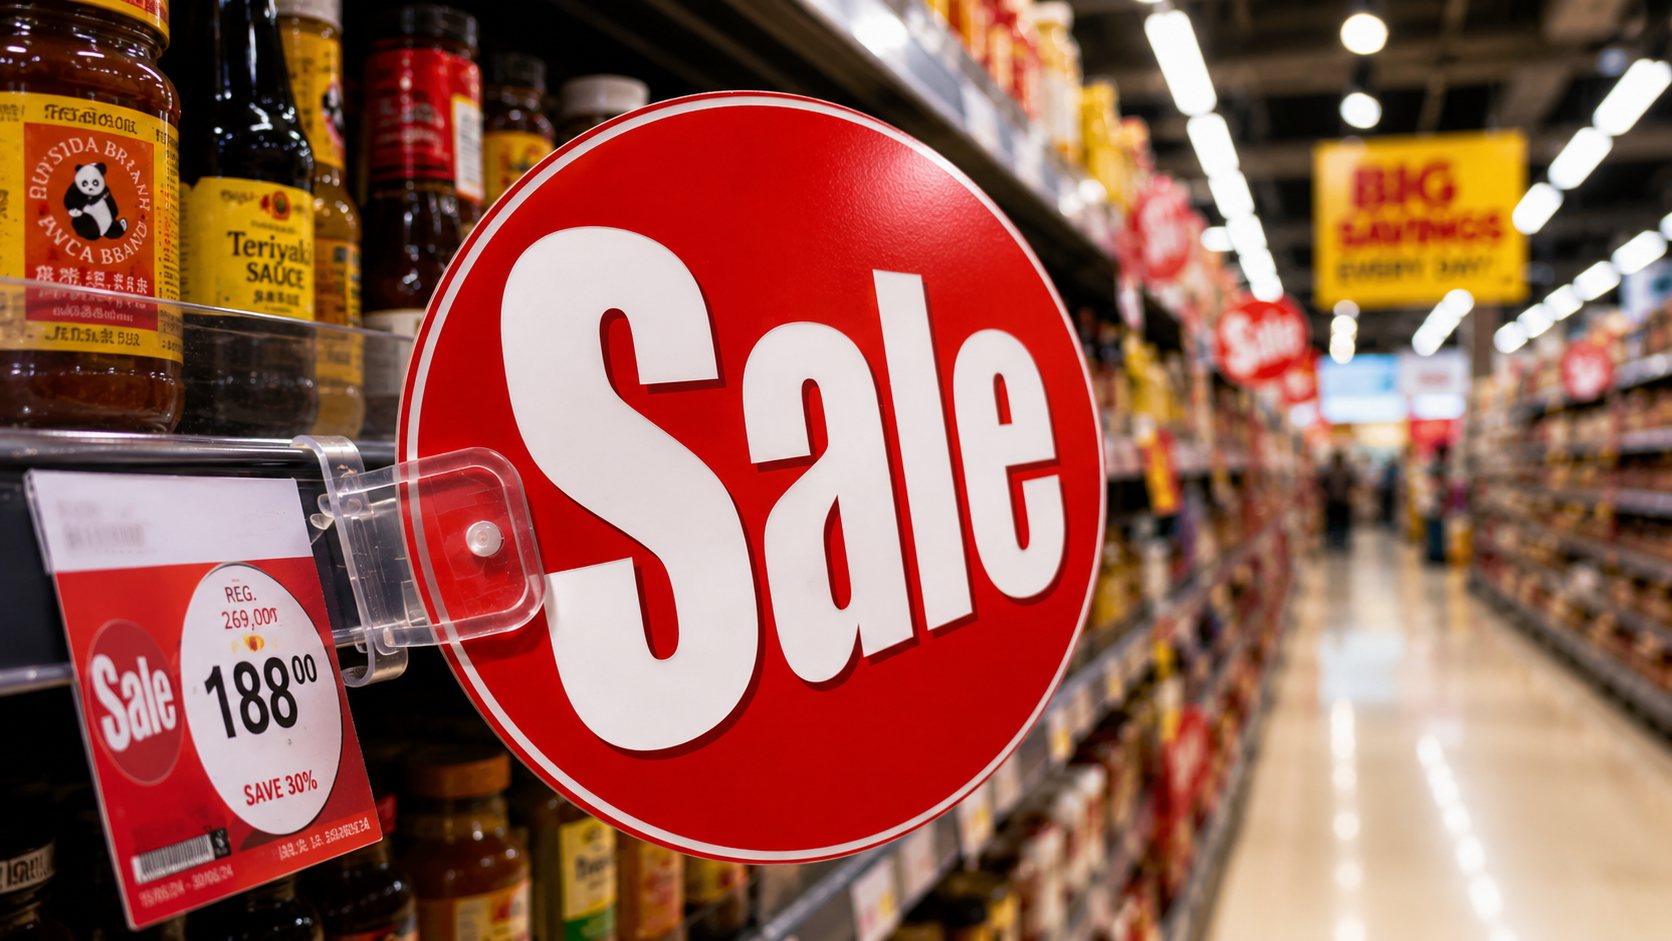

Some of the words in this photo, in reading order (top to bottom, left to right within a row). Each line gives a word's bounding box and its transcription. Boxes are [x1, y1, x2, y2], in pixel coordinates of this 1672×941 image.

[1354, 161, 1457, 210] BIG
[227, 231, 311, 266] Teriyaki
[246, 262, 304, 289] SAUCE
[501, 226, 1066, 751] Sale
[224, 585, 257, 603] REG.
[91, 653, 176, 752] Sale
[204, 657, 298, 739] 188
[244, 778, 284, 806] SAVE
[285, 769, 318, 796] 30%
